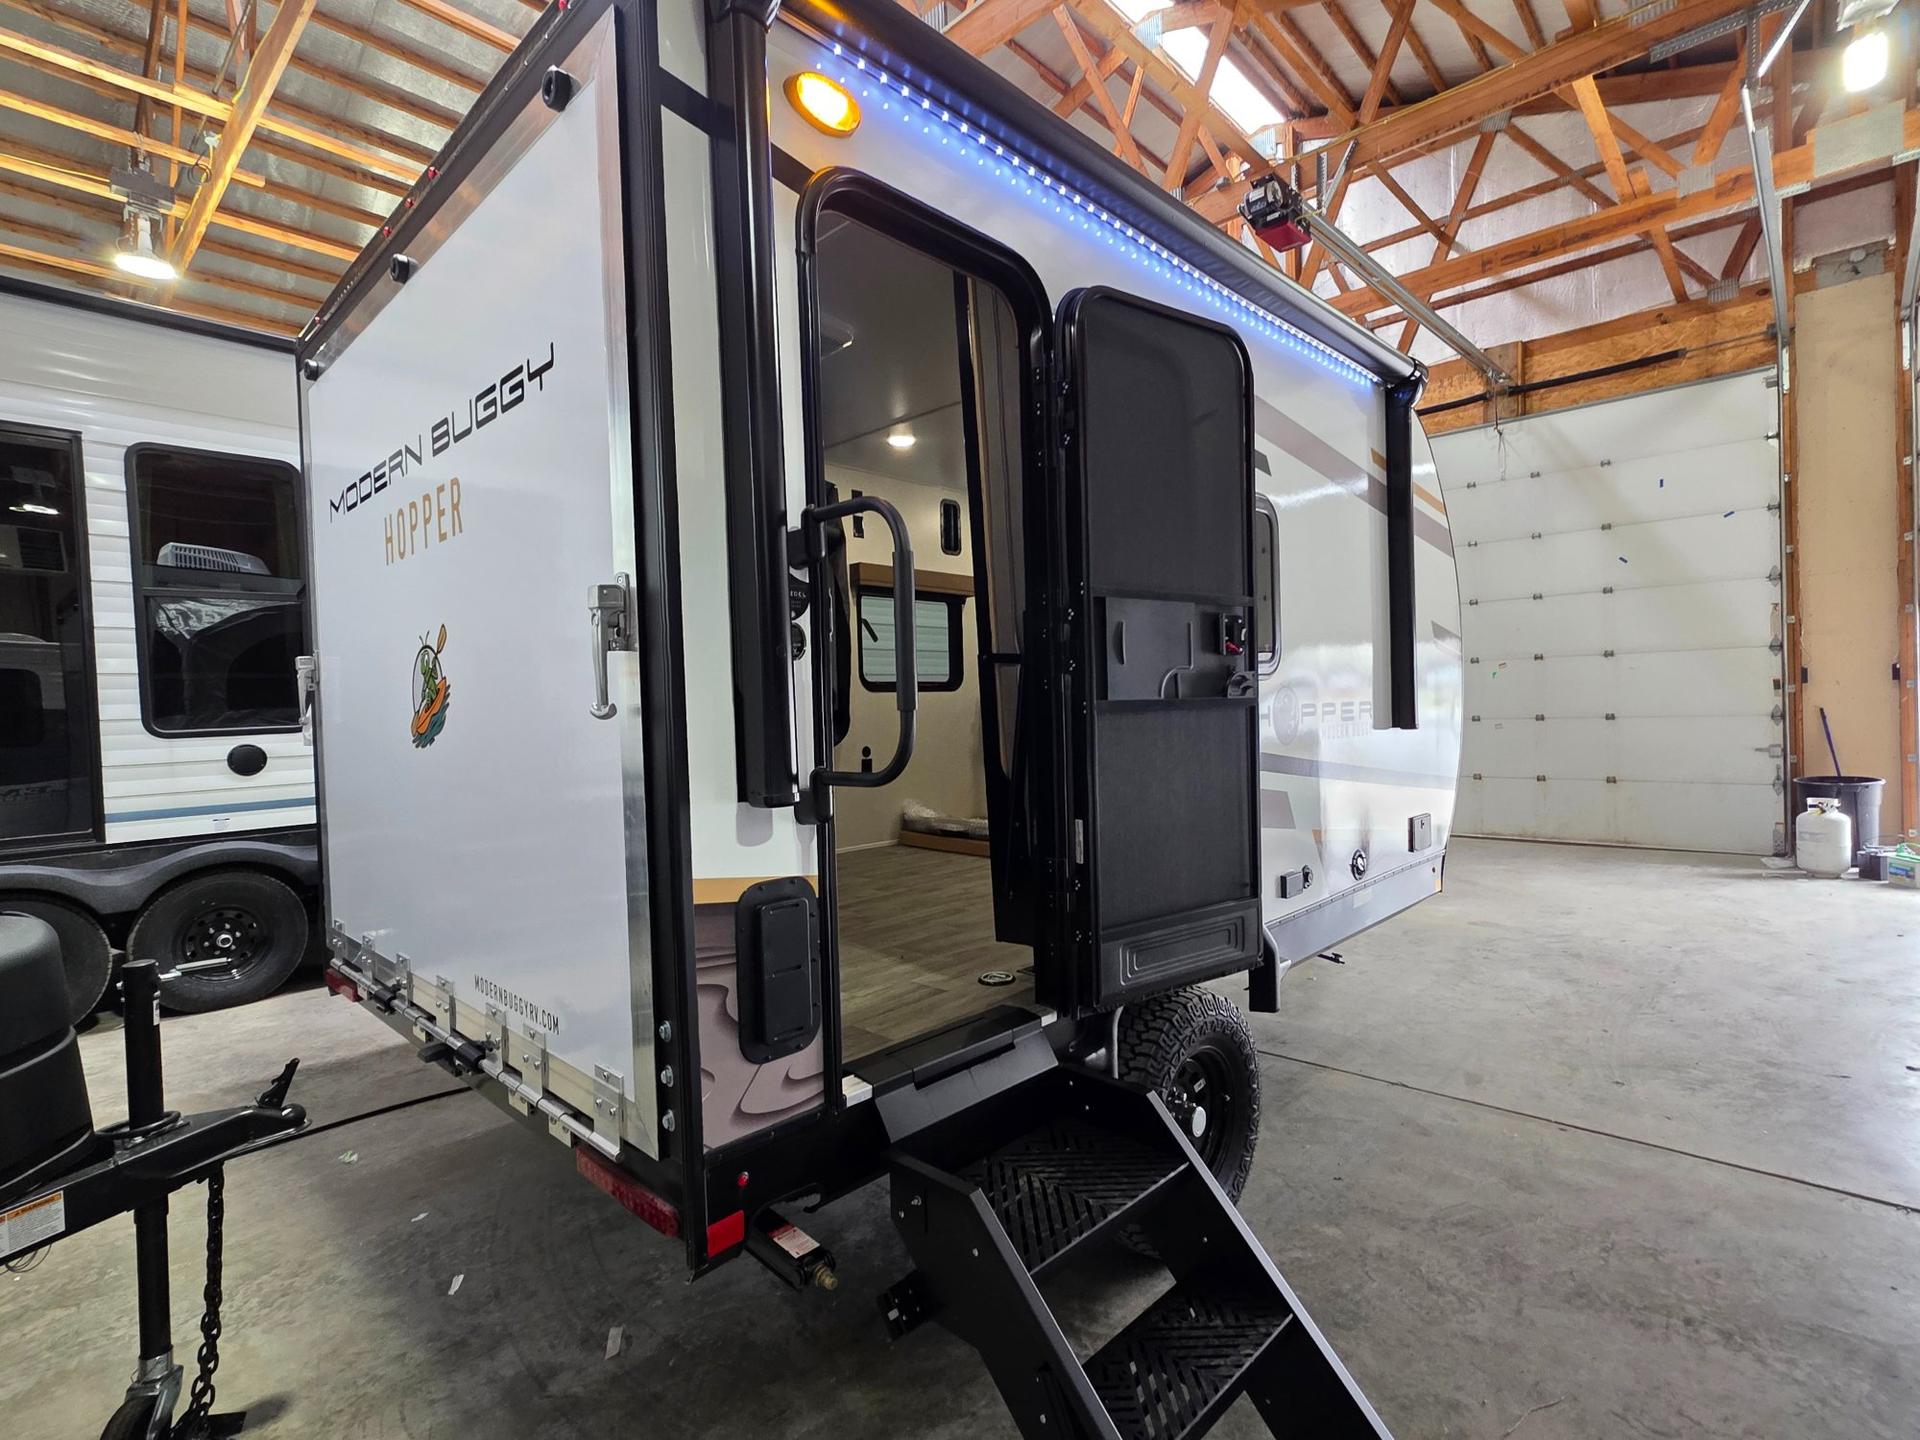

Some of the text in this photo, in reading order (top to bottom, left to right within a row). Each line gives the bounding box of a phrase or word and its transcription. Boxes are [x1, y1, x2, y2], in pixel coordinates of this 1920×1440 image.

[330, 341, 554, 523] MODERN BUGGY
[384, 477, 463, 565] HOPPER
[474, 974, 559, 1035] MODERNBUGGYRV.COM
